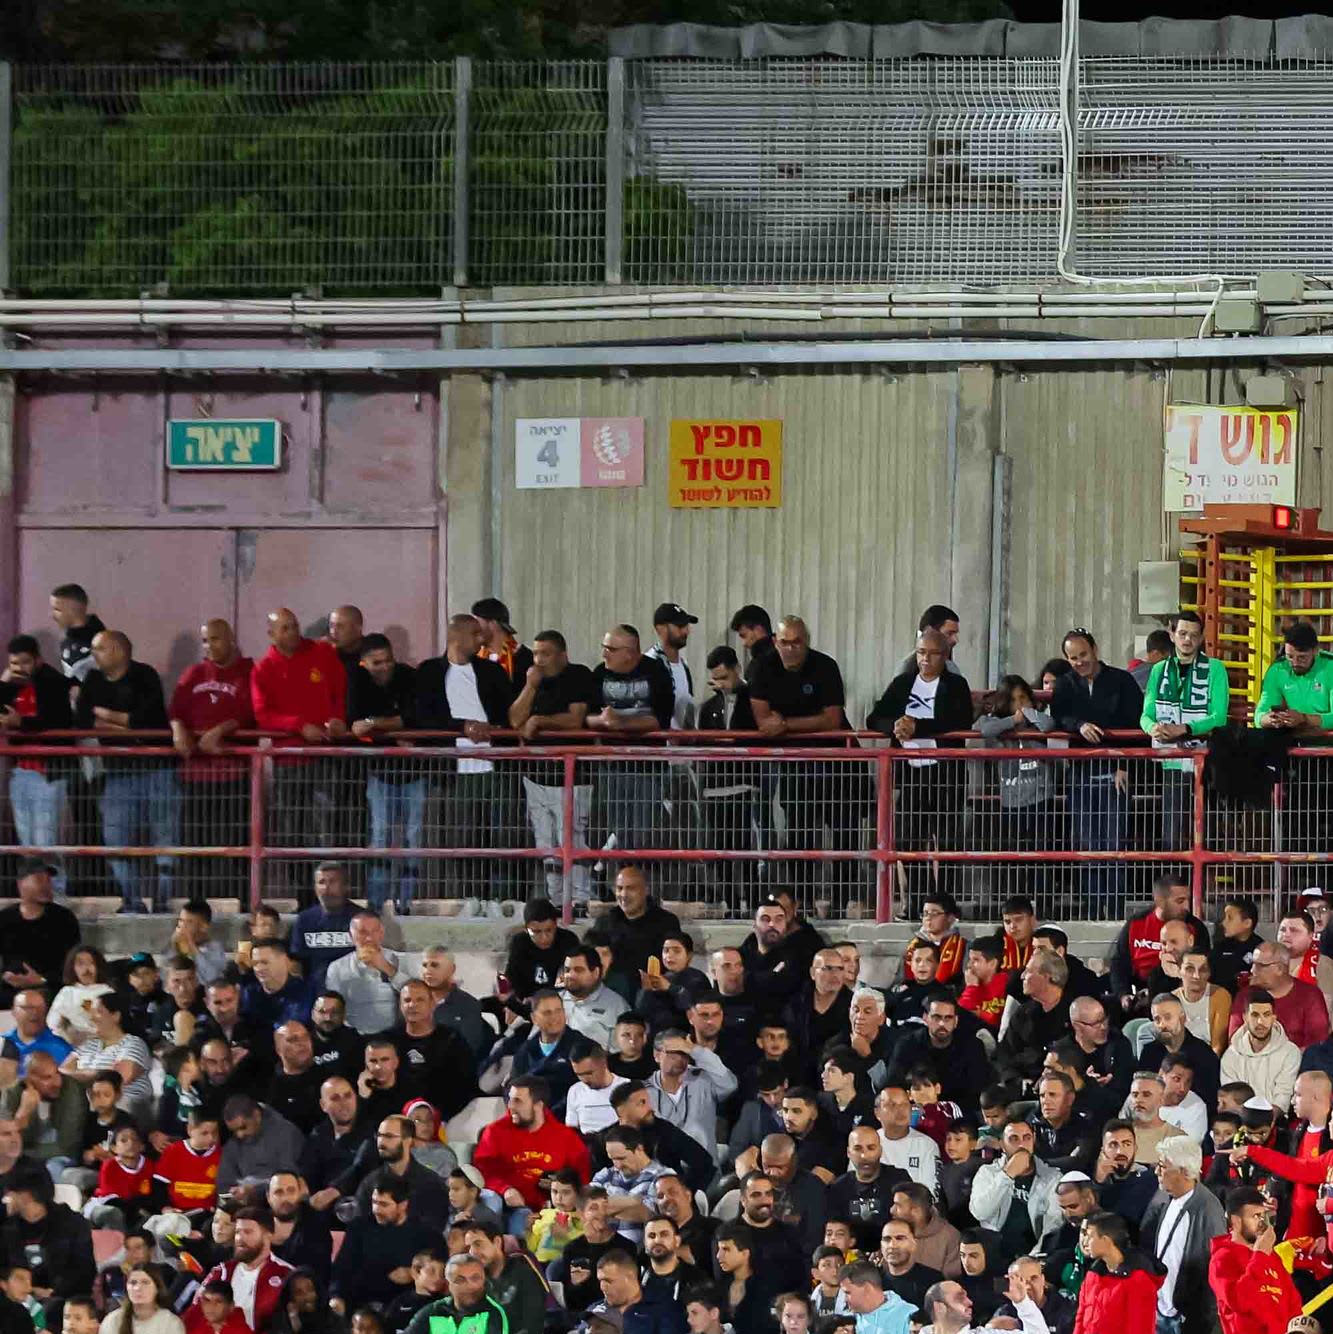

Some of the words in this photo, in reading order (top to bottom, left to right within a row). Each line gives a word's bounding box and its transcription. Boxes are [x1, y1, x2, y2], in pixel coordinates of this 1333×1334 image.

[185, 426, 260, 462] יציאה
[529, 425, 567, 436] יציאה
[690, 425, 762, 455] חפץ
[1220, 414, 1292, 465] גוש
[537, 440, 559, 467] 4
[681, 458, 770, 481] חשוד
